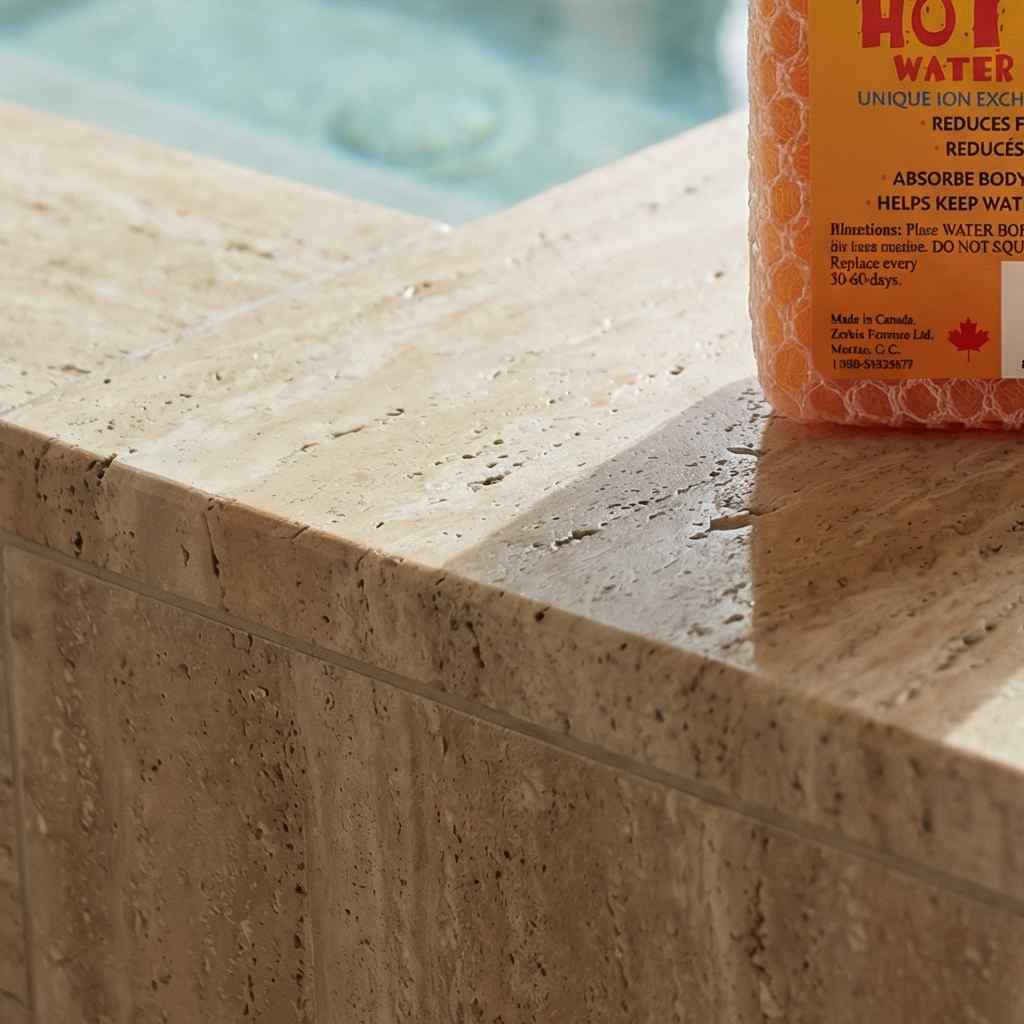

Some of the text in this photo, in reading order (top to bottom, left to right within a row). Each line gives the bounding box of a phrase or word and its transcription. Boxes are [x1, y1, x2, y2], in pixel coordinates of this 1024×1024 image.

[893, 54, 1014, 82] WATER
[857, 92, 931, 109] UNIQUE
[937, 92, 970, 107] ION
[932, 116, 1010, 132] REDUCES
[893, 171, 974, 186] ABSORBE
[878, 196, 931, 211] HELPS
[935, 196, 978, 211] KEEP
[943, 224, 993, 236] WATER
[933, 240, 955, 253] DO
[959, 240, 990, 253] NOT
[831, 257, 917, 272] Replace every
